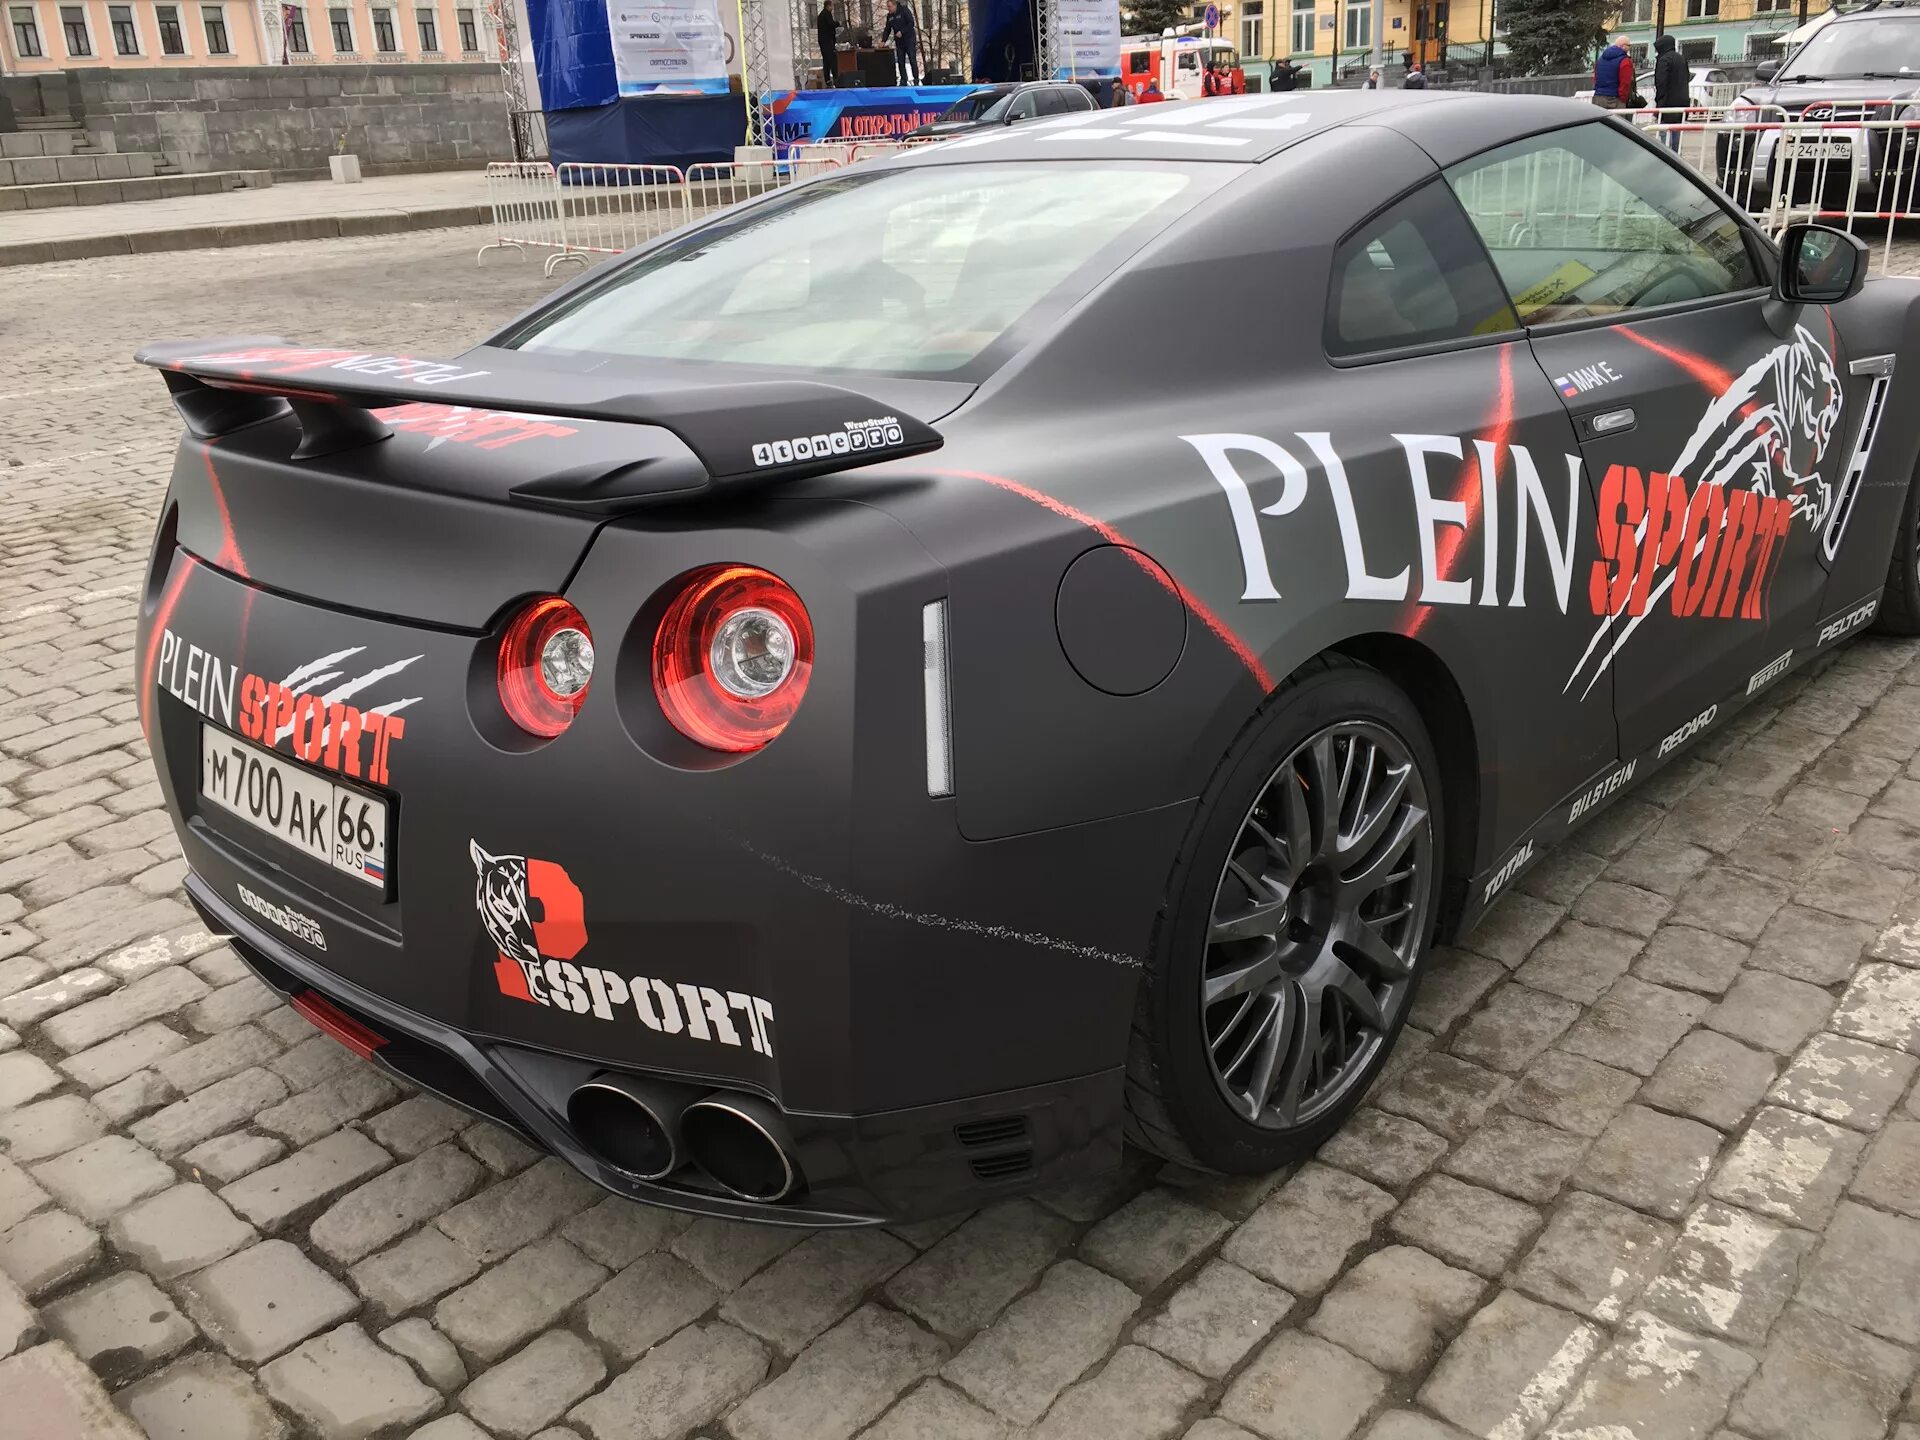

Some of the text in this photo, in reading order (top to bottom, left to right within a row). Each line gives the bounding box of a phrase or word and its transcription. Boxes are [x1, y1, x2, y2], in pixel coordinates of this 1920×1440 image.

[854, 109, 920, 135] ОТКРЫТЫЙ
[1567, 365, 1609, 392] MAK
[1177, 432, 1583, 615] PLEIN
[1589, 464, 1793, 619] SPORT
[1816, 600, 1877, 647] PELTOR
[157, 628, 239, 729] PLEIN
[1746, 649, 1794, 696] PIRELLI
[239, 673, 405, 785] SPORT
[1657, 705, 1717, 759] RECARO
[1568, 758, 1637, 825] BILSTEIN
[337, 795, 375, 852] 66
[336, 844, 363, 870] RUS
[1483, 839, 1535, 905] TOTAL
